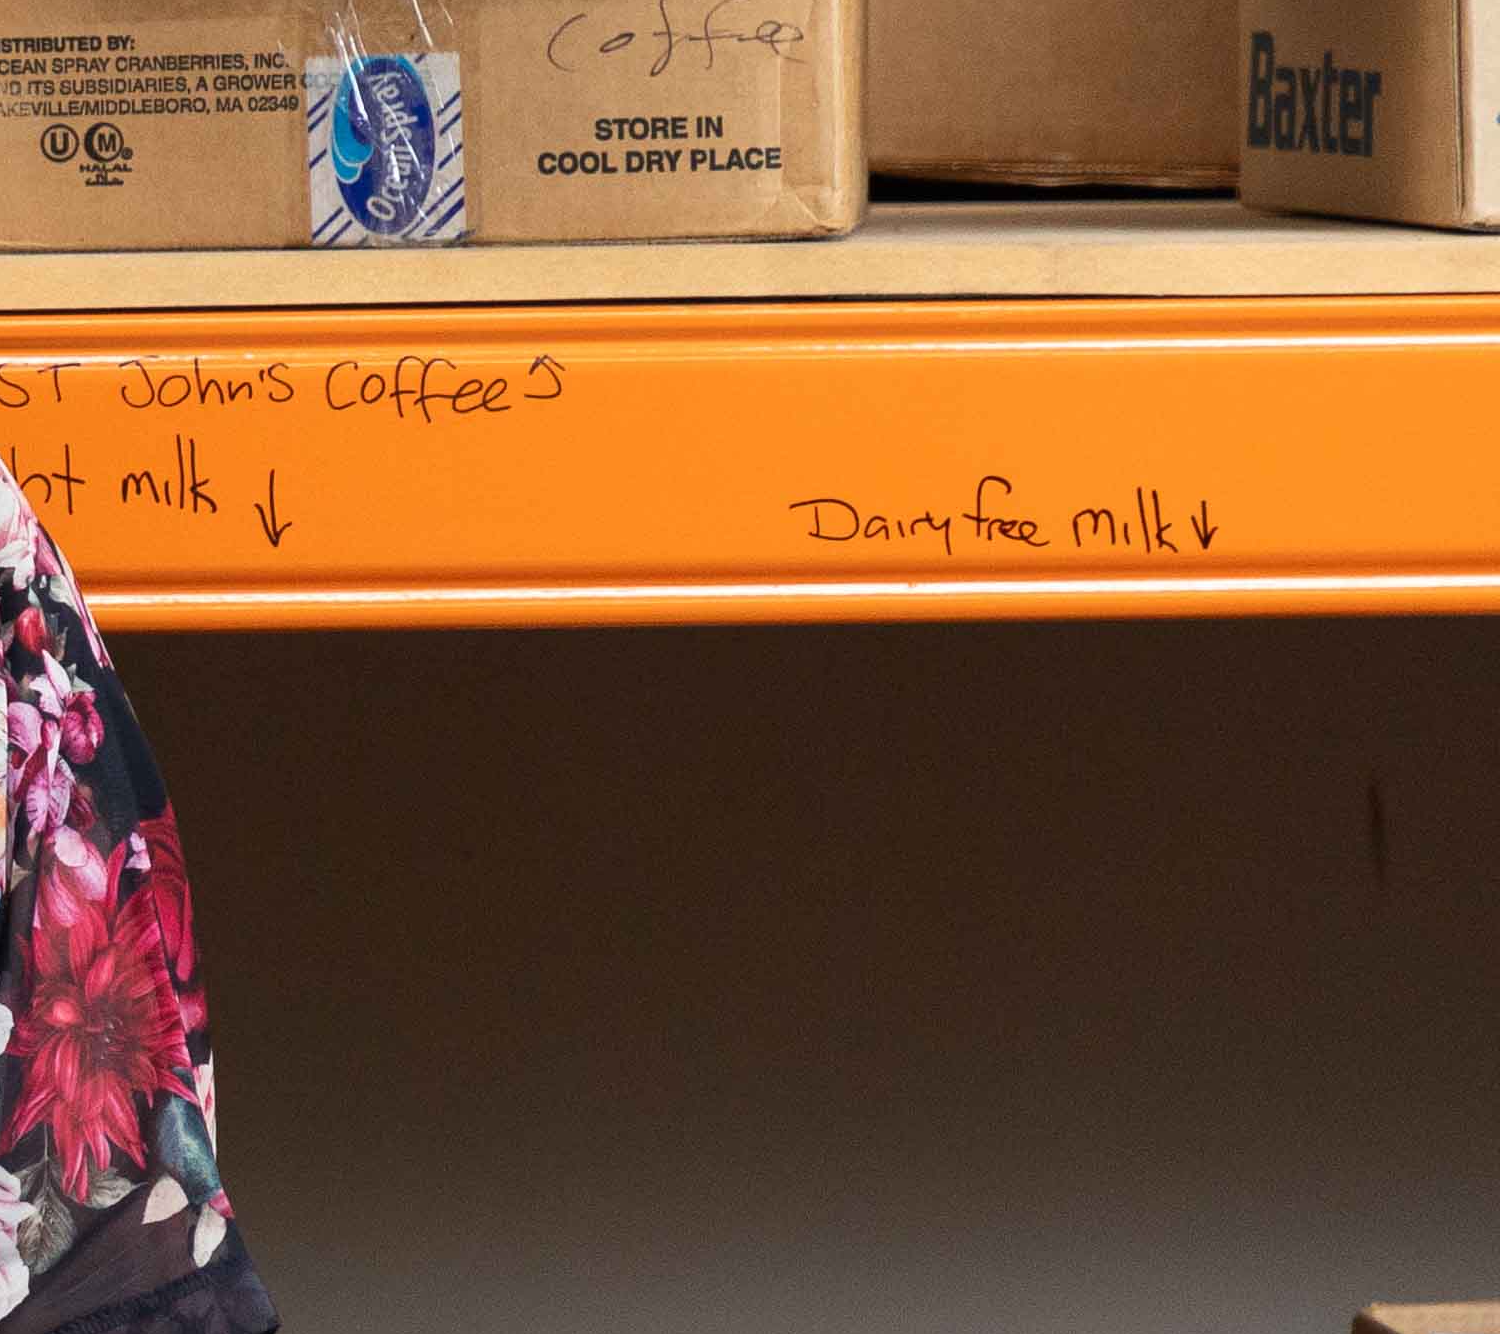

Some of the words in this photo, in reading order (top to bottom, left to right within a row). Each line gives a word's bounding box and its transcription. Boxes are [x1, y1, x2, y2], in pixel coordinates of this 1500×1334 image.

[107, 35, 135, 51] BY:
[52, 56, 111, 74] SPRAY
[115, 54, 249, 72] CRANBERRIES,
[254, 52, 290, 69] INC.
[27, 79, 55, 95] ITS
[60, 77, 191, 96] SUBSIDIARIES,
[196, 76, 208, 92] A
[213, 74, 296, 92] GROWER
[1247, 30, 1382, 157] Baxter
[217, 97, 244, 113] MA
[248, 95, 299, 112] 02349
[595, 117, 687, 140] STORE
[697, 115, 723, 138] IN
[79, 162, 133, 173] HALAL
[538, 152, 618, 174] COOL
[625, 149, 681, 173] DRY
[690, 147, 782, 170] PLACE
[326, 355, 512, 423] Coffee
[790, 498, 953, 555] Dairy
[962, 476, 1049, 546] free
